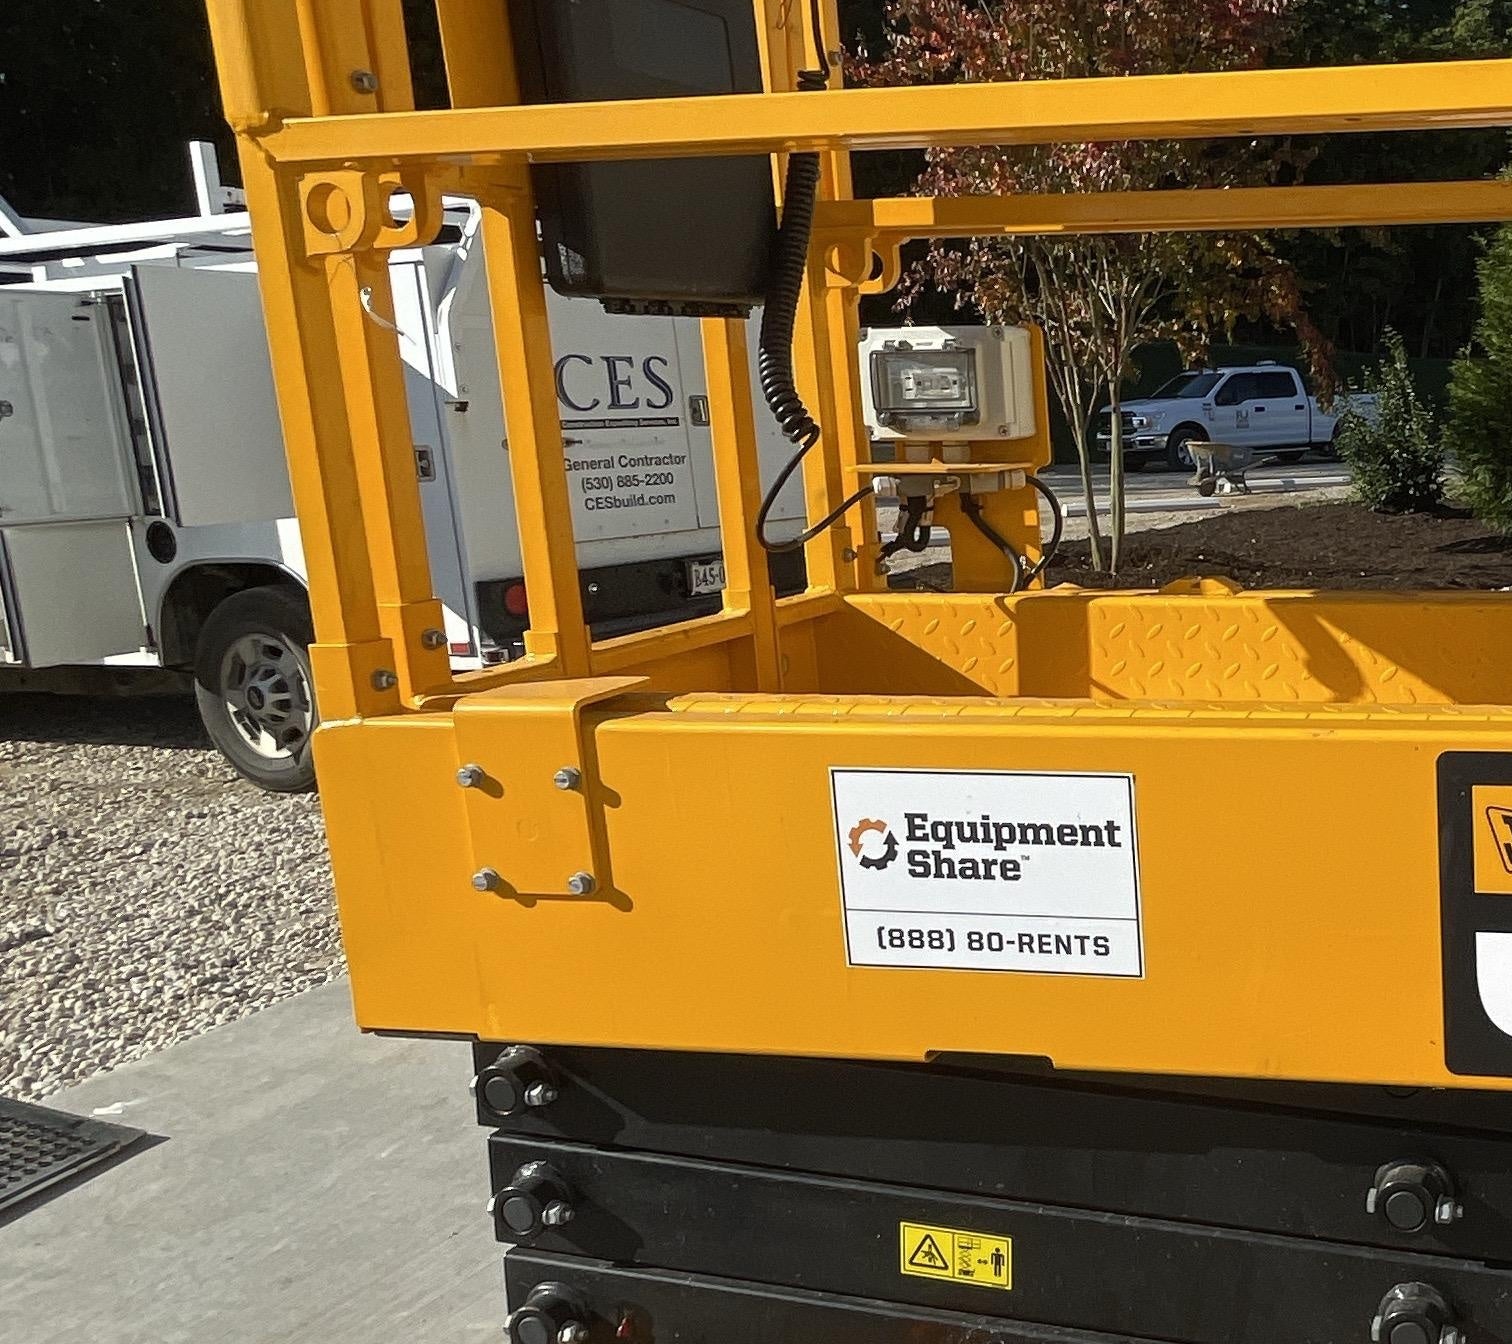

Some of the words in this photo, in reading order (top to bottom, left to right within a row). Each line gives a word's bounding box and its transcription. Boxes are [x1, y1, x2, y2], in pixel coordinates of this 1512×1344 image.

[554, 354, 675, 412] CES
[563, 455, 615, 472] General
[618, 453, 687, 468] Contractor
[581, 475, 614, 494] (530)
[584, 493, 677, 511] CESbuild.com
[903, 812, 1122, 852] Equipment
[906, 849, 1022, 882] Share
[876, 925, 957, 953] (888)
[966, 931, 1111, 958] 80-RENTS
